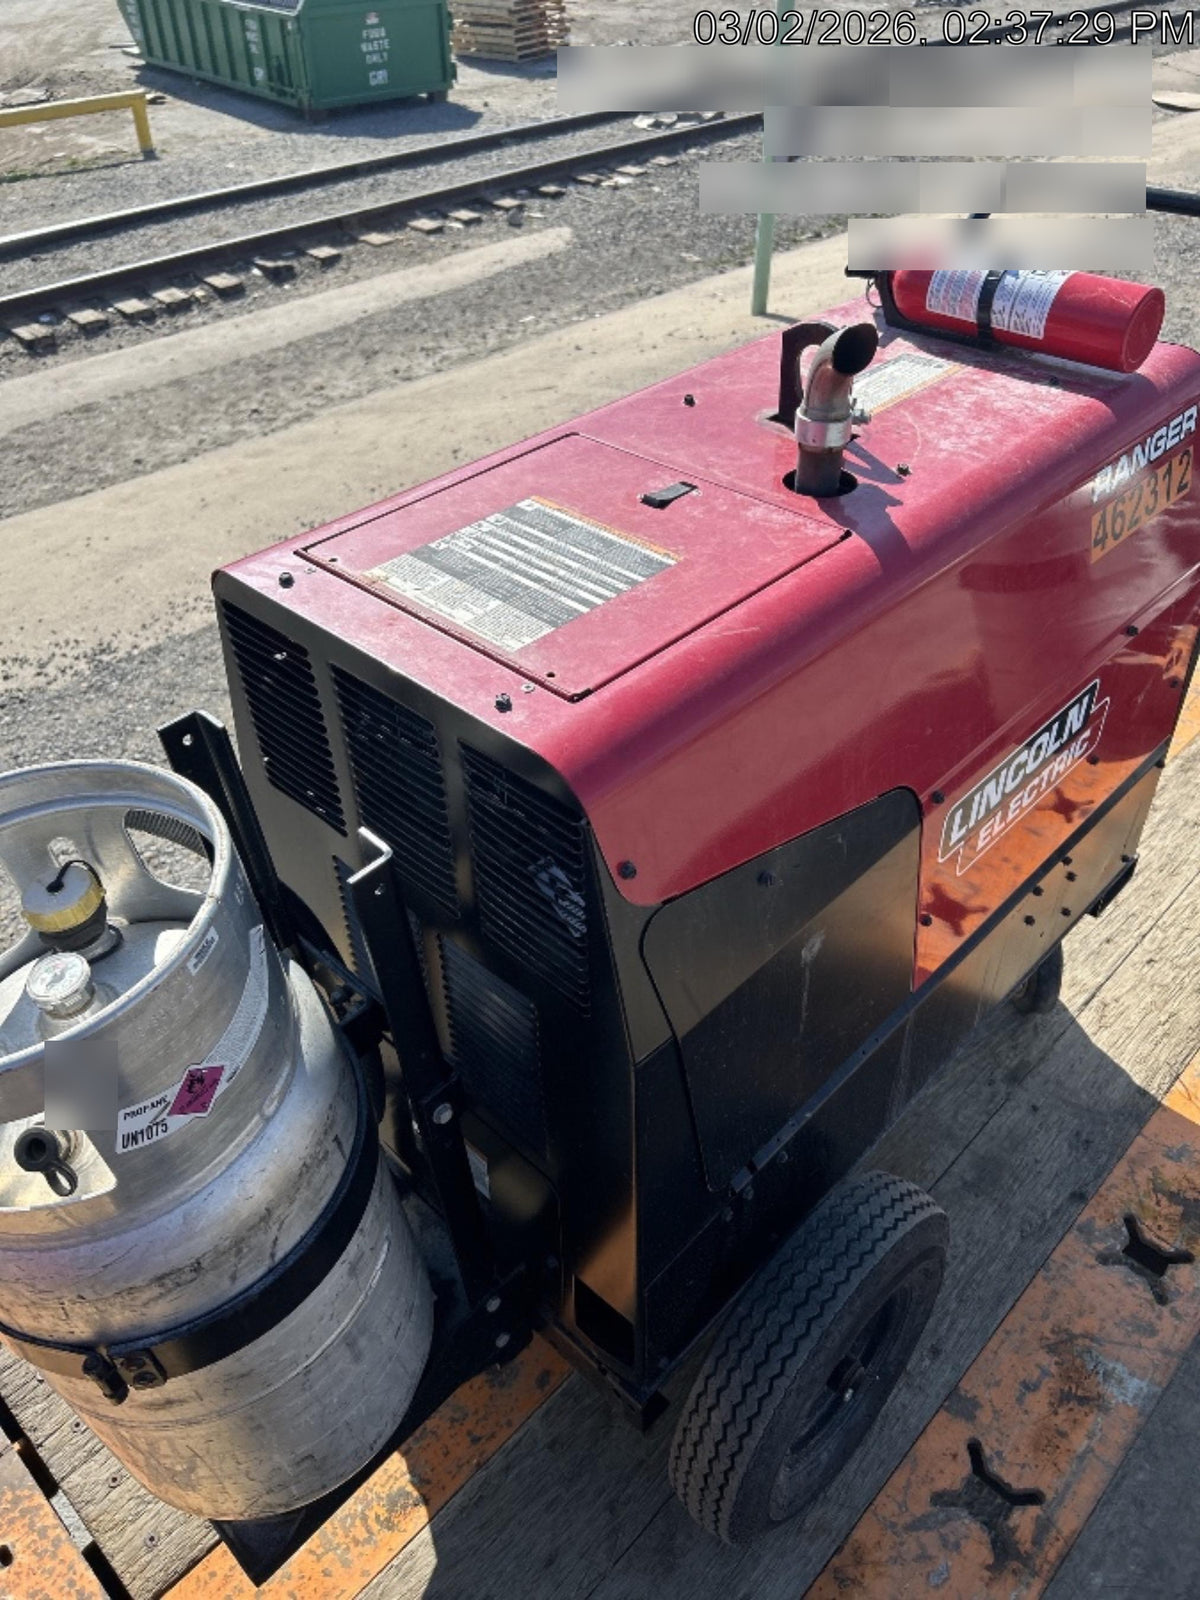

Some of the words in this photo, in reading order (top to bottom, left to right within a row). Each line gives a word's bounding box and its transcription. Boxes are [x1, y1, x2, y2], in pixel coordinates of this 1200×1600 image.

[1092, 404, 1198, 503] RANGER
[1092, 450, 1192, 551] 462312
[949, 693, 1092, 847] LINCOLN
[976, 727, 1091, 852] ELECTRIC
[121, 1118, 168, 1149] UN1075
